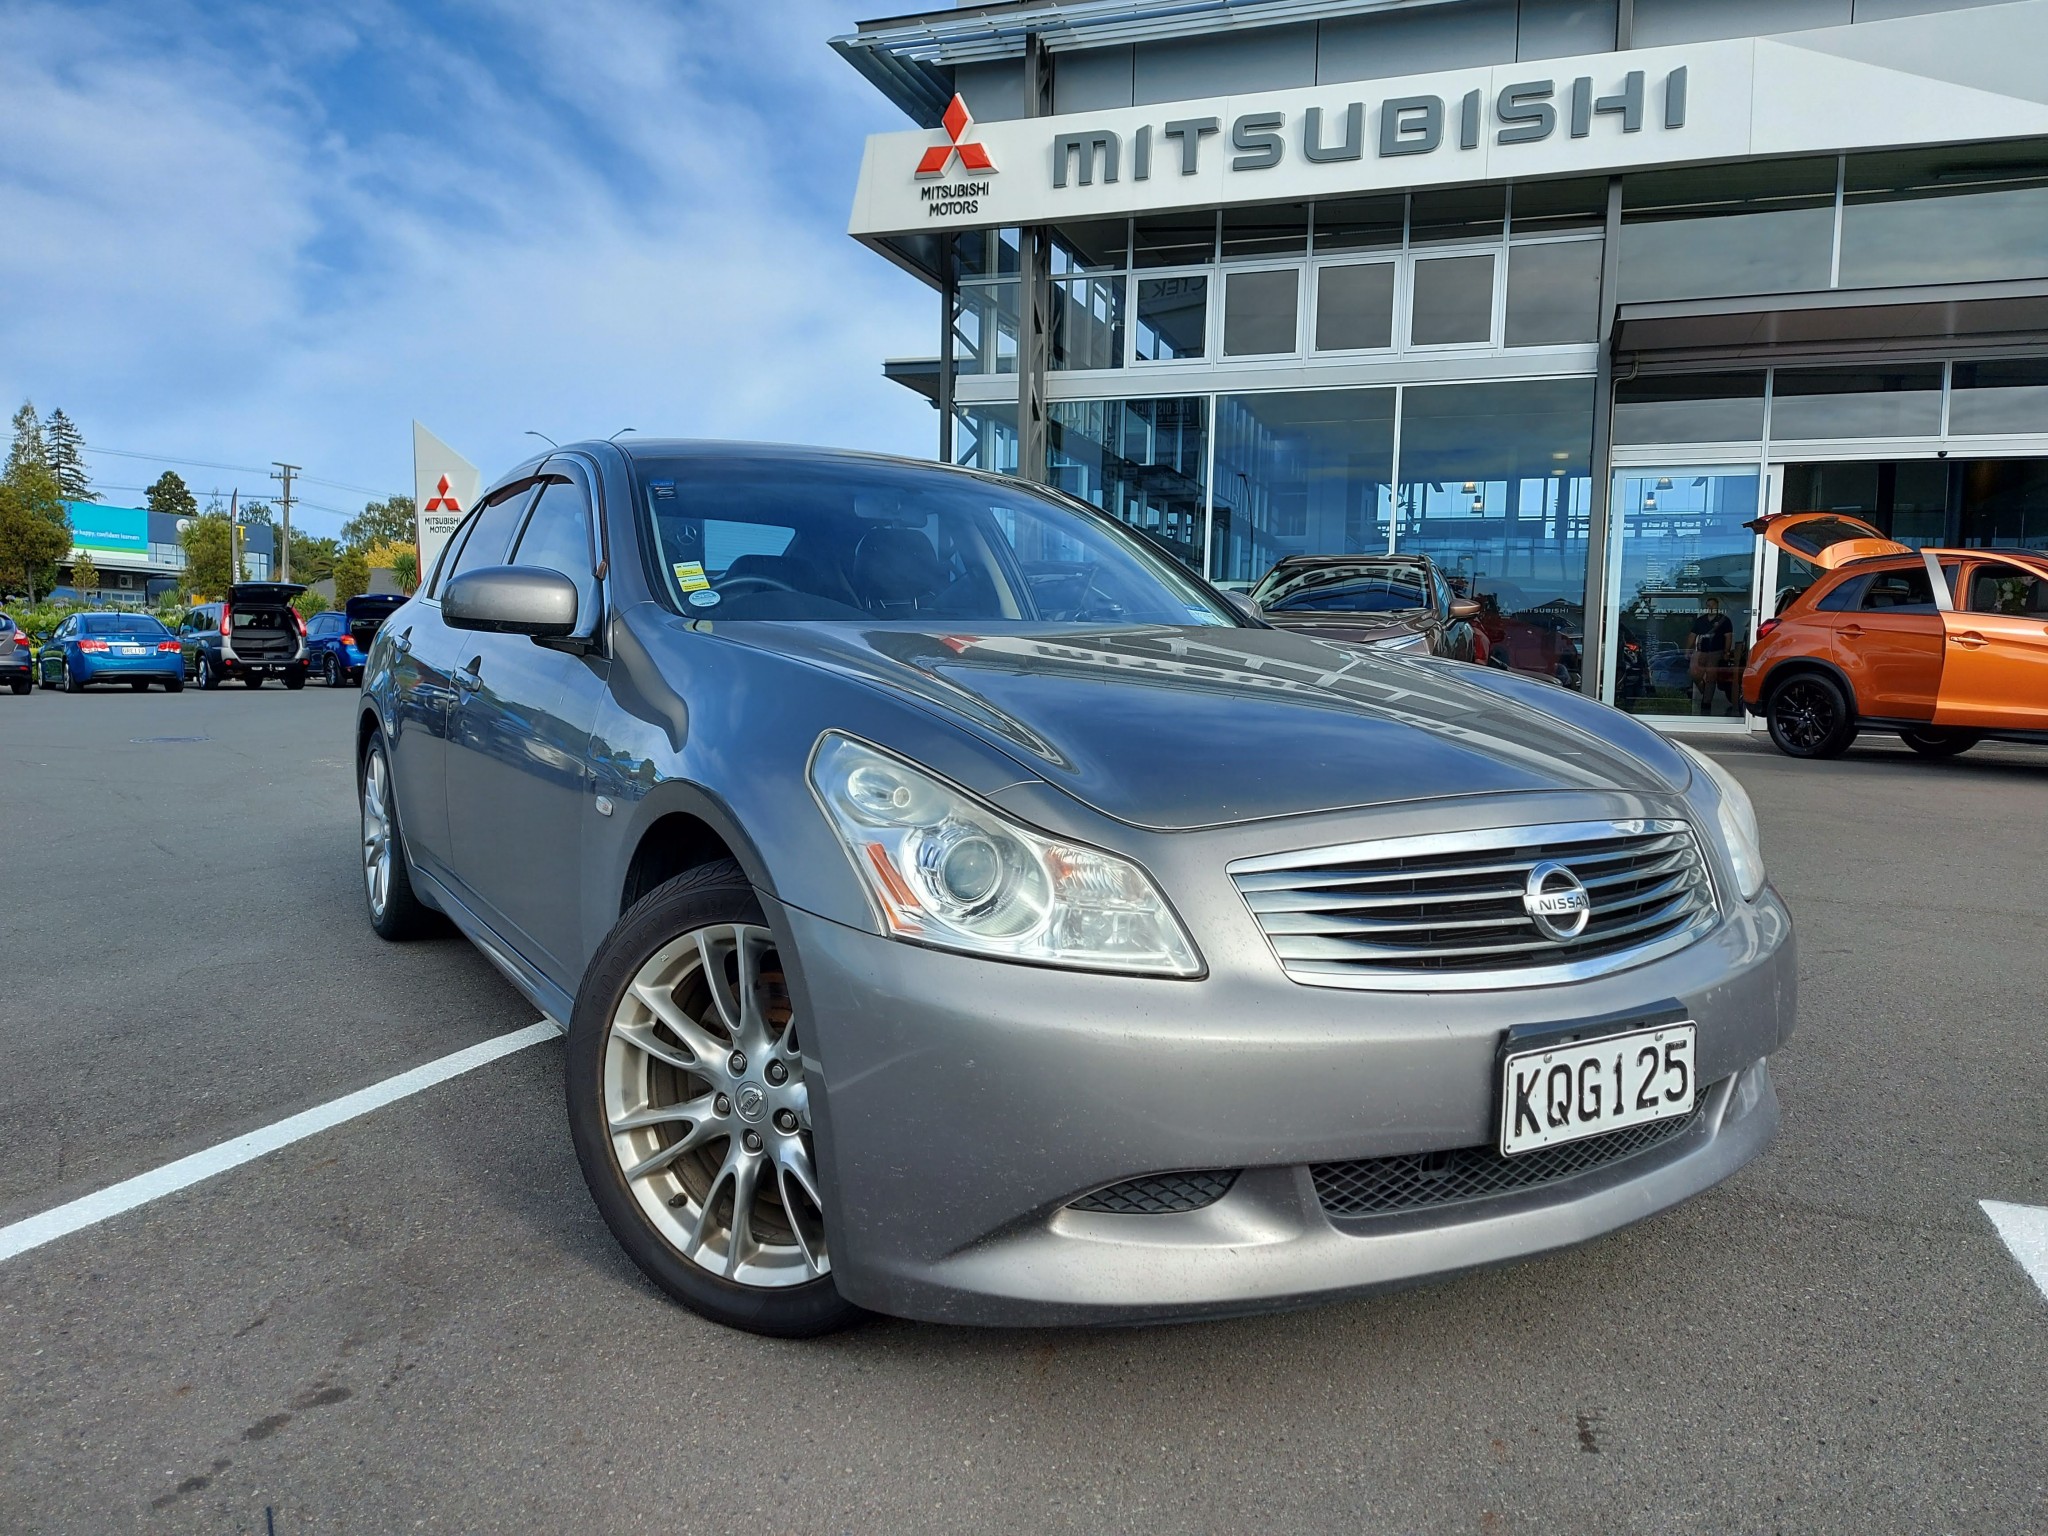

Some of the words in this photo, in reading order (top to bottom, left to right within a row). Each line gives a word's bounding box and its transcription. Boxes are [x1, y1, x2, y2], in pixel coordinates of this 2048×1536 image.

[1052, 64, 1687, 188] MITSUBISHI
[921, 182, 989, 200] MITSUBISHI
[929, 200, 978, 217] MOTORS
[425, 517, 461, 525] MITSUBISHI
[1539, 894, 1588, 911] NISSAN
[1514, 1040, 1688, 1138] KQG125
